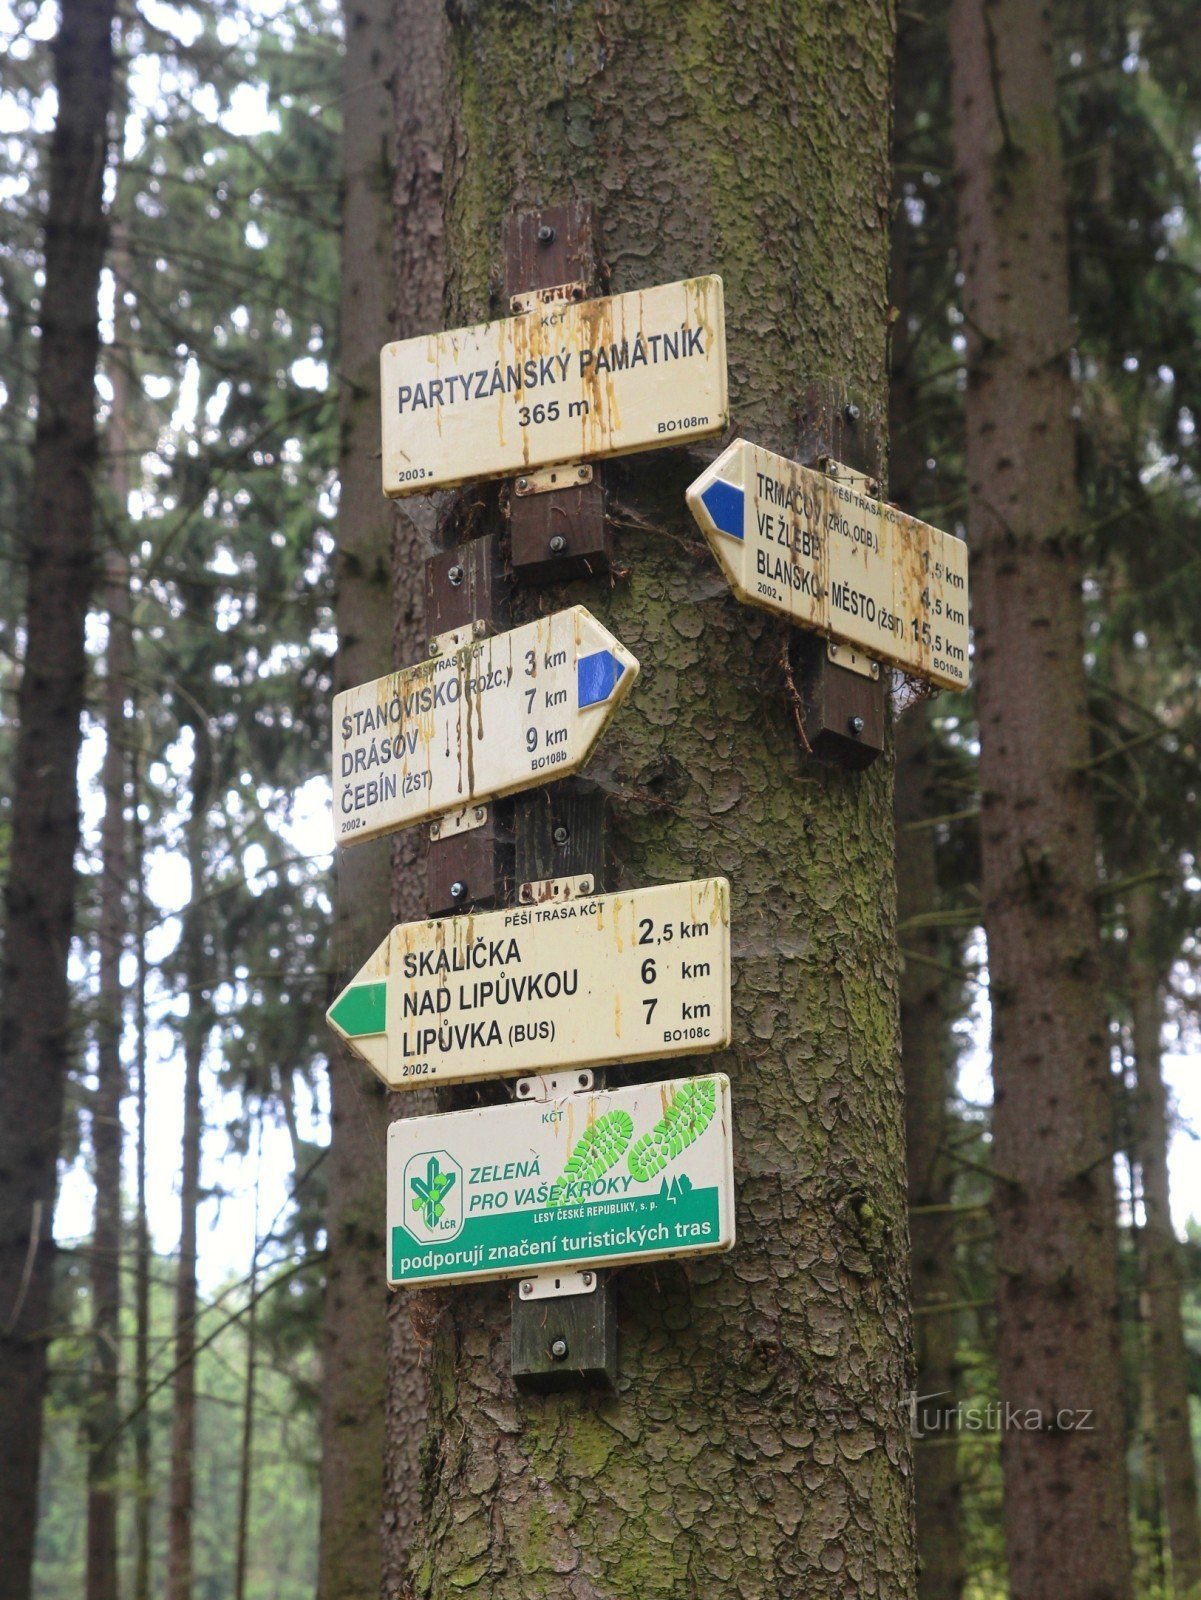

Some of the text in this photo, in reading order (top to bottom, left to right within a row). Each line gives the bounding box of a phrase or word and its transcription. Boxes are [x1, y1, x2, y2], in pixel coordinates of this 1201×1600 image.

[540, 313, 567, 328] KČT
[398, 322, 705, 413] PARTYZÁNSKÝ PAMÁTNÍK
[517, 400, 589, 427] 365 m
[657, 416, 709, 434] BO108m
[855, 495, 882, 516] TRASA
[756, 509, 774, 541] VE
[945, 566, 964, 590] km
[757, 549, 821, 598] BLANSKO
[831, 580, 876, 622] MĚSTO
[877, 607, 904, 639] (ŽST)
[921, 586, 942, 616] 4,5
[945, 602, 964, 626] km
[911, 617, 964, 662] 15,5 km
[933, 657, 963, 679] BO108a
[341, 677, 461, 740] STANOVISKO
[524, 650, 536, 675] 3
[545, 649, 567, 669] km
[341, 687, 567, 777] DRÁSOV 7 km
[341, 726, 568, 814] ČEBÍN (ŽST) 9 km
[531, 751, 567, 771] BO108b
[504, 902, 604, 927] PĚŠÍ TRASA KČT
[403, 918, 709, 979] SKALIČKA 2,5 km
[403, 958, 710, 1018] NAD LIPŮVKOU 6 km
[403, 998, 711, 1057] LIPŮVKA (BUS) 7 km
[663, 1027, 710, 1043] BO108c
[541, 1111, 564, 1124] KČT
[468, 1156, 541, 1185] ZELENÁ
[469, 1176, 633, 1212] PRO VAŠE KROKY
[440, 1219, 456, 1231] LČR
[533, 1210, 555, 1224] LESY
[556, 1206, 585, 1221] ČESKÉ
[587, 1201, 638, 1218] REPUBLIKY,
[400, 1220, 711, 1274] podporují značení turistických tras
